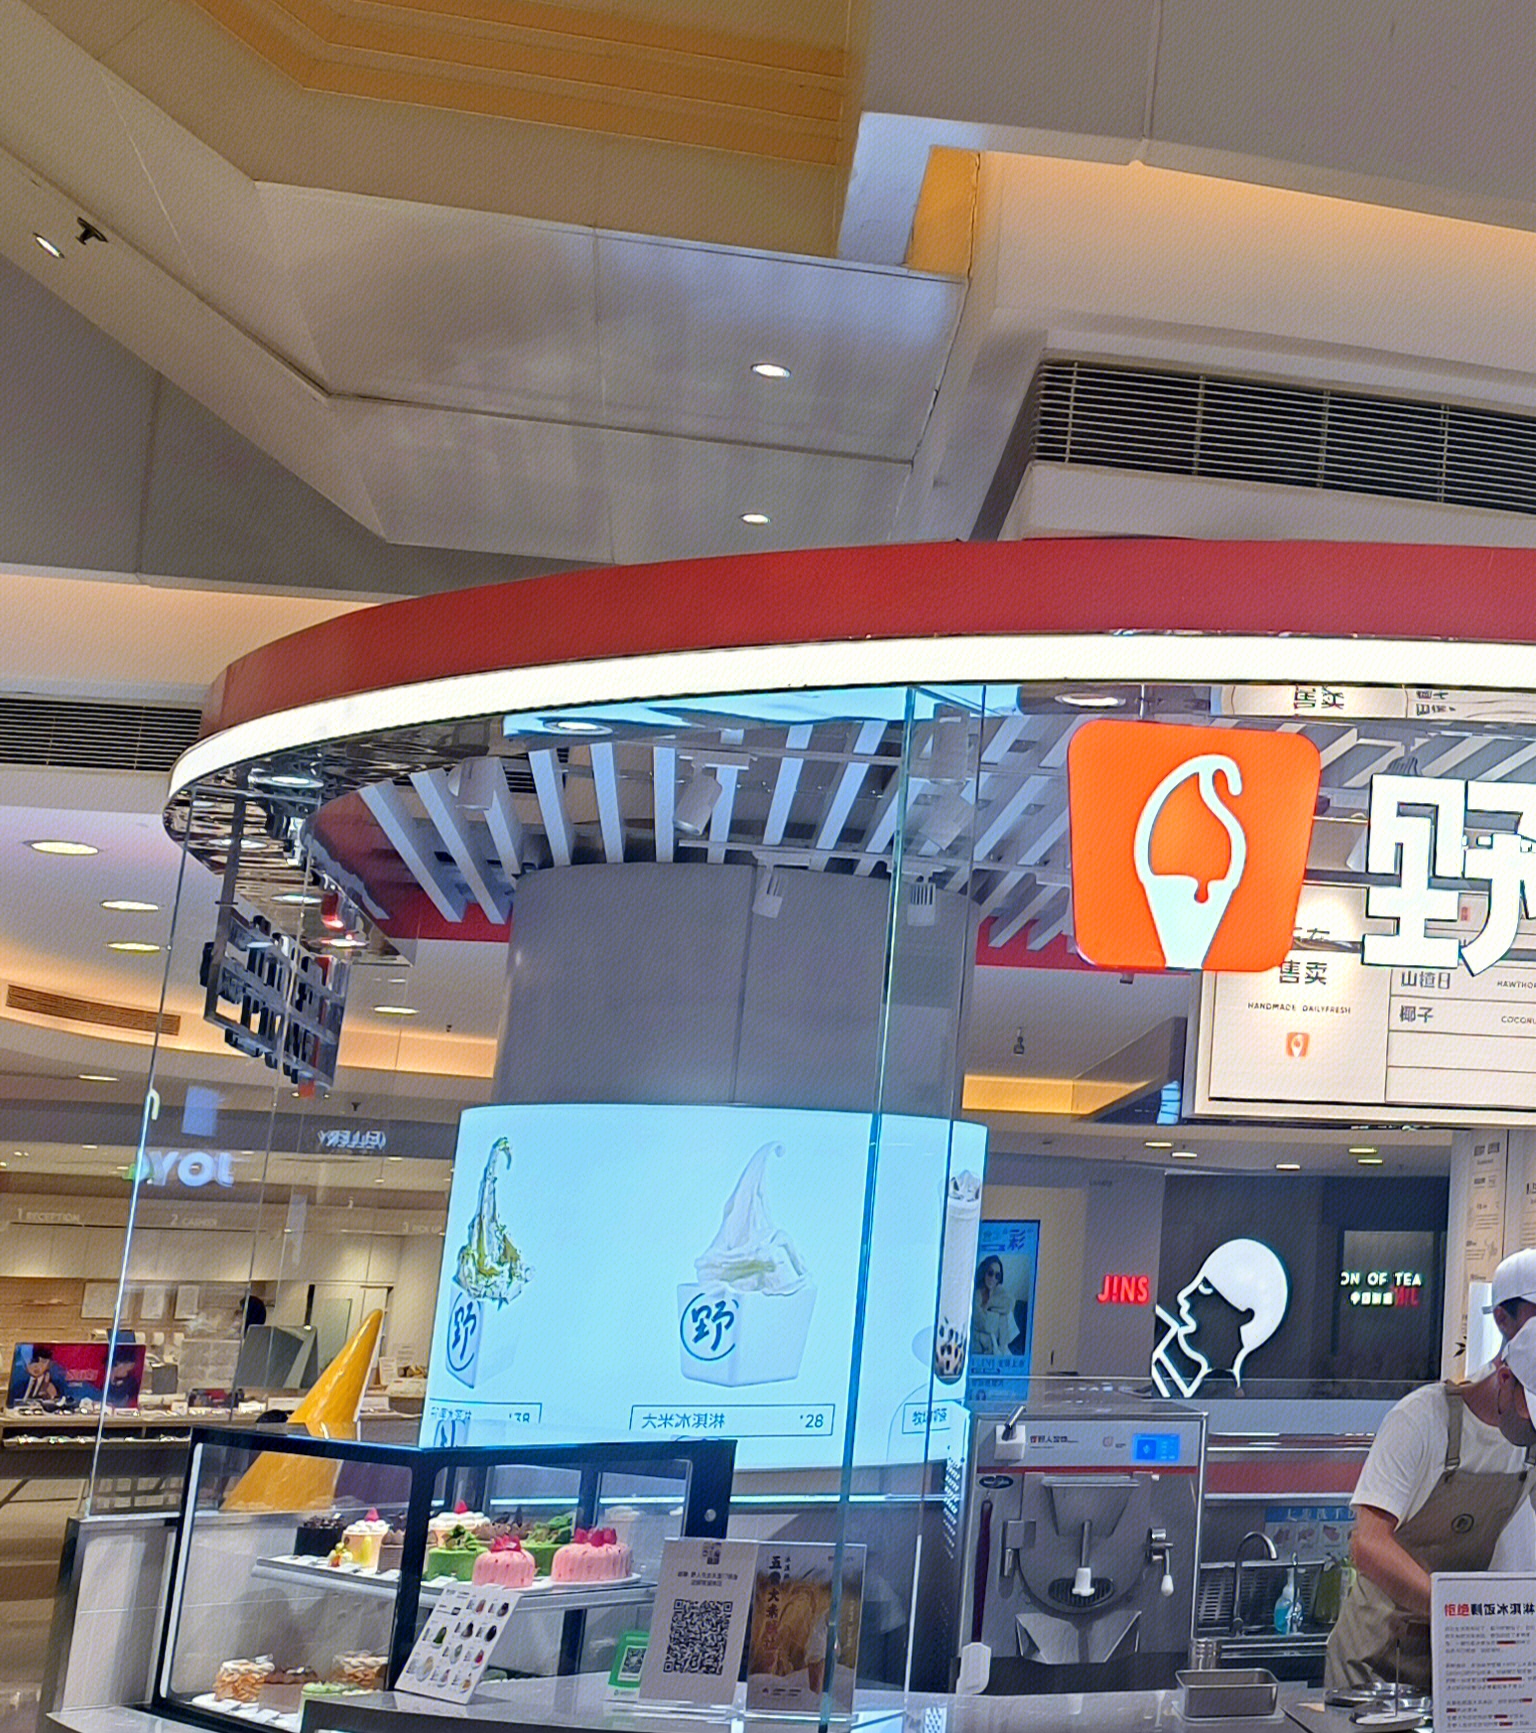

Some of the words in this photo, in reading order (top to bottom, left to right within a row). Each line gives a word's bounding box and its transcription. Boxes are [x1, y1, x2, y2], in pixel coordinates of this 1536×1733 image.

[1279, 960, 1328, 985] 售卖
[1247, 1001, 1296, 1013] HANDMADE
[1302, 1003, 1351, 1015] DAILYFRESH
[1399, 1005, 1434, 1023] 椰子
[1367, 1271, 1388, 1286] OF
[1394, 1271, 1422, 1287] TEA
[1097, 1275, 1149, 1303] JINS
[641, 1412, 725, 1430] 大米冰淇淋
[1444, 1602, 1536, 1617] 拒绝剩饭冰淇淋
